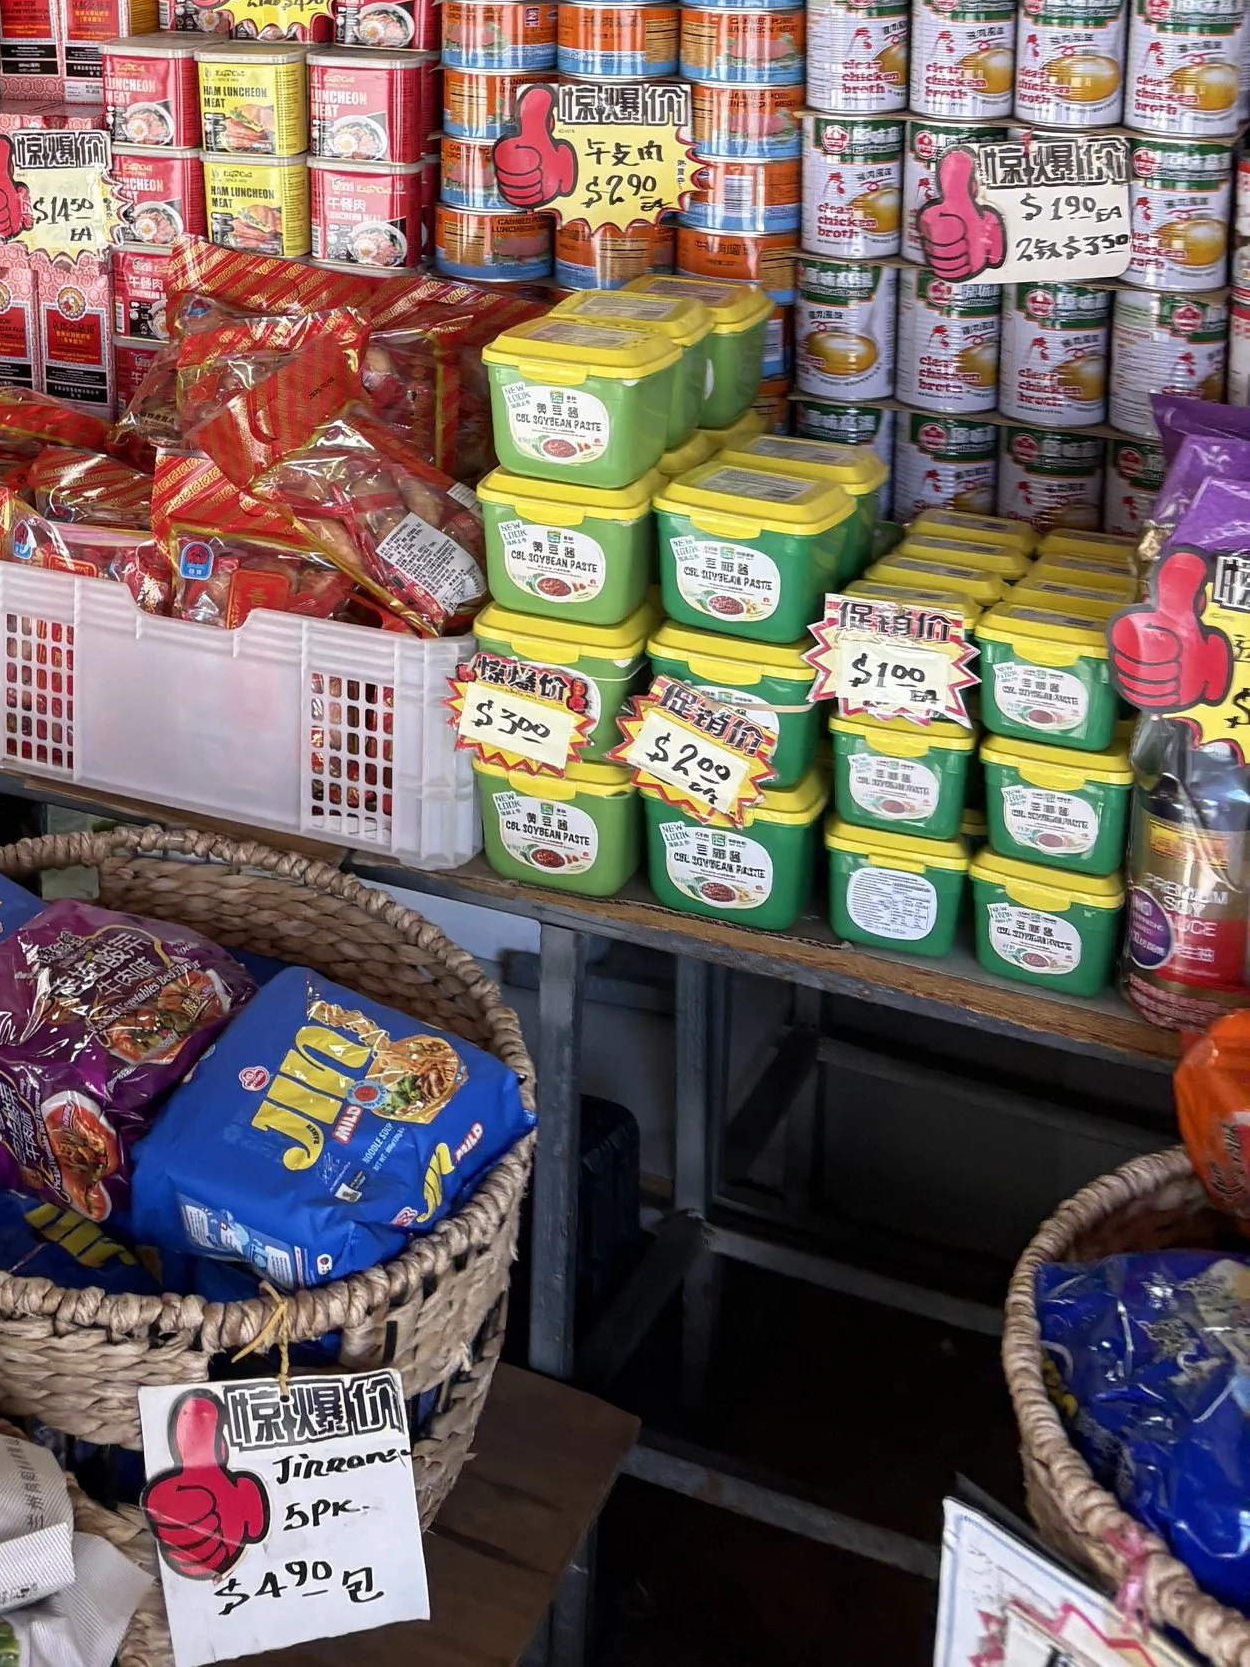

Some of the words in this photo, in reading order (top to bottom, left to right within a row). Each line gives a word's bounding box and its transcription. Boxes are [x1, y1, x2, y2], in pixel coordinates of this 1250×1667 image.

[204, 86, 221, 96] HAM
[223, 86, 267, 97] LUNCHEON
[311, 89, 367, 105] LUNCHEON
[204, 98, 225, 108] MEAT
[559, 85, 688, 126] 惊爆价
[14, 132, 108, 168] 惊爆价
[979, 140, 1130, 190] 惊爆价
[211, 186, 228, 195] HAM
[231, 186, 274, 199] LUNCHEON
[212, 198, 232, 208] MEAT
[70, 226, 92, 242] EA
[515, 412, 530, 424] CBL
[532, 413, 573, 430] SOYBEAN
[573, 418, 602, 432] PASTE
[511, 549, 527, 562] CBL
[528, 551, 568, 569] SOYBEAN
[569, 558, 598, 573] PASTE
[494, 793, 517, 804] NEW
[505, 820, 522, 833] CBL
[522, 822, 562, 841] SOYBEAN
[562, 830, 591, 846] PASTE
[332, 1104, 363, 1145] MILD
[361, 1137, 383, 1165] NOODLE
[223, 1376, 407, 1451] 惊爆价
